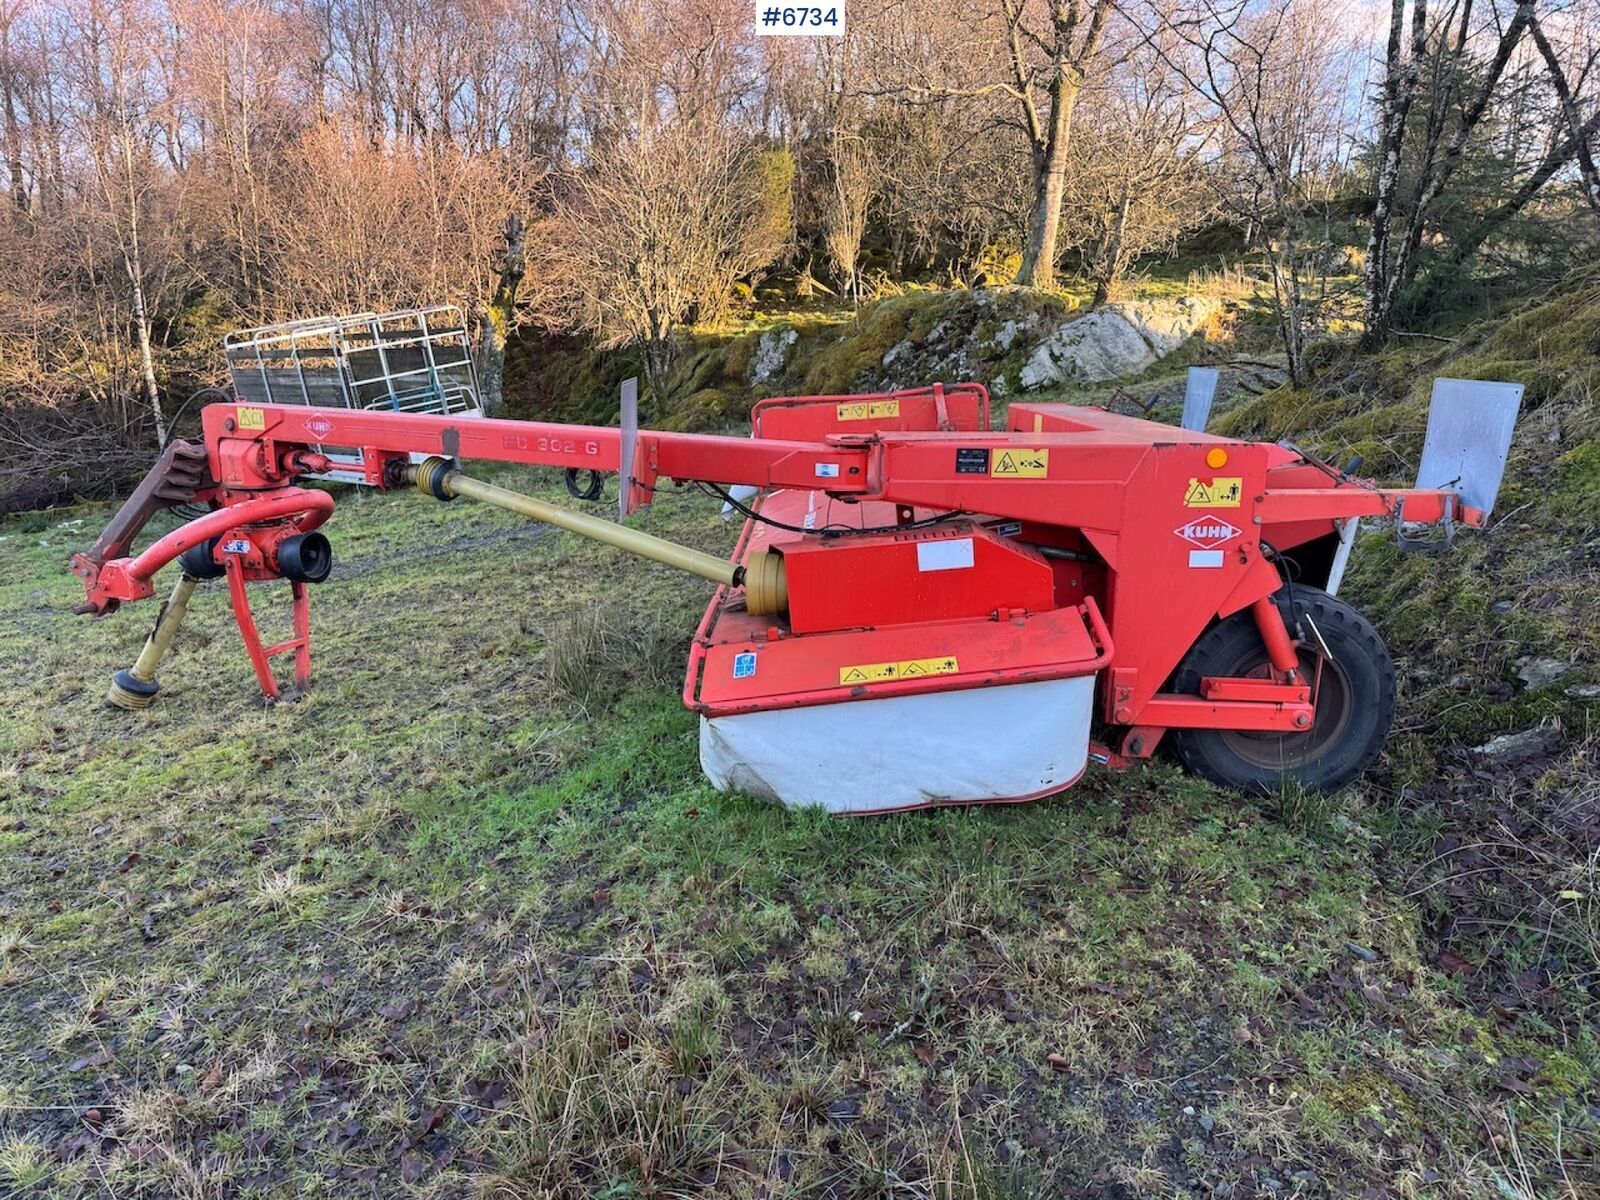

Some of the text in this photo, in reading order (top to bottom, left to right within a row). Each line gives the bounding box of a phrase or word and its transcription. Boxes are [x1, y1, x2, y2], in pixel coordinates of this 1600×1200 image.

[537, 438, 576, 454] 302
[585, 440, 598, 455] G
[1184, 525, 1232, 539] KUHN
